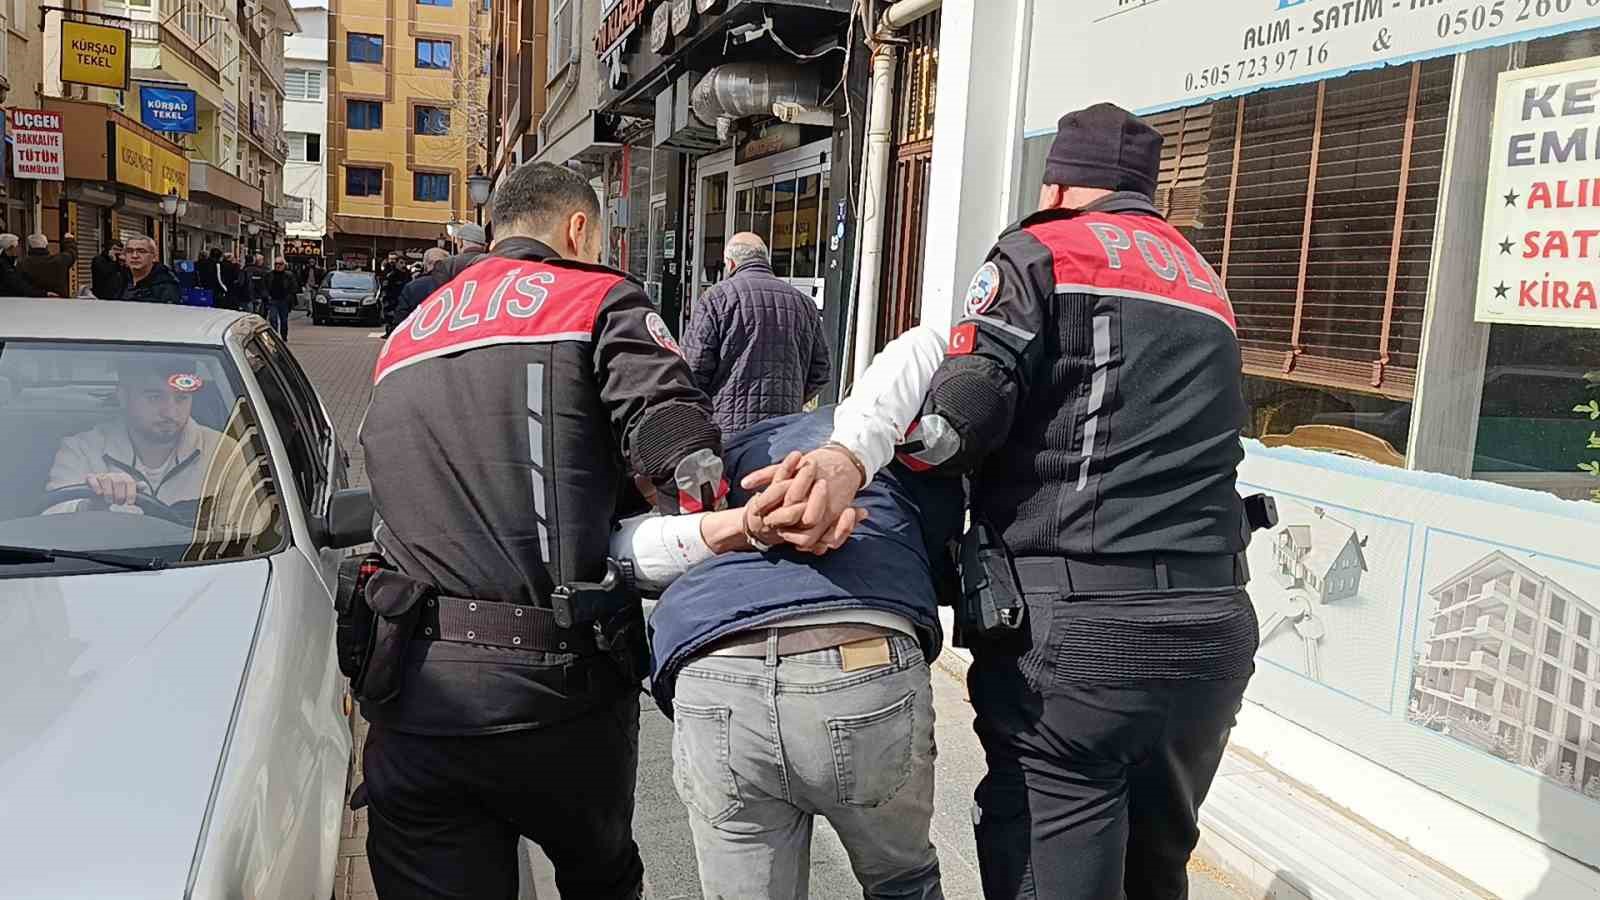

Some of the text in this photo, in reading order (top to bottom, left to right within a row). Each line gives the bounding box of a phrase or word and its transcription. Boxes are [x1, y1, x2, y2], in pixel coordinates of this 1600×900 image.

[1243, 18, 1290, 50] ALIM
[1312, 0, 1383, 34] SATIM
[72, 38, 117, 55] KÜRŞAD
[1184, 64, 1230, 92] 0.505
[1238, 55, 1268, 81] 723
[1275, 48, 1298, 74] 97
[1306, 40, 1329, 66] 16
[1372, 27, 1393, 51] &
[1437, 1, 1504, 39] 0505
[77, 53, 112, 68] TEKEL
[147, 99, 188, 112] KÜRŞAD
[153, 110, 184, 120] TEKEL
[14, 110, 59, 130] ÜÇGEN
[18, 148, 58, 163] TÜTÜN
[1508, 126, 1600, 167] EM
[1527, 177, 1600, 210] ALI
[1522, 229, 1600, 259] SAT
